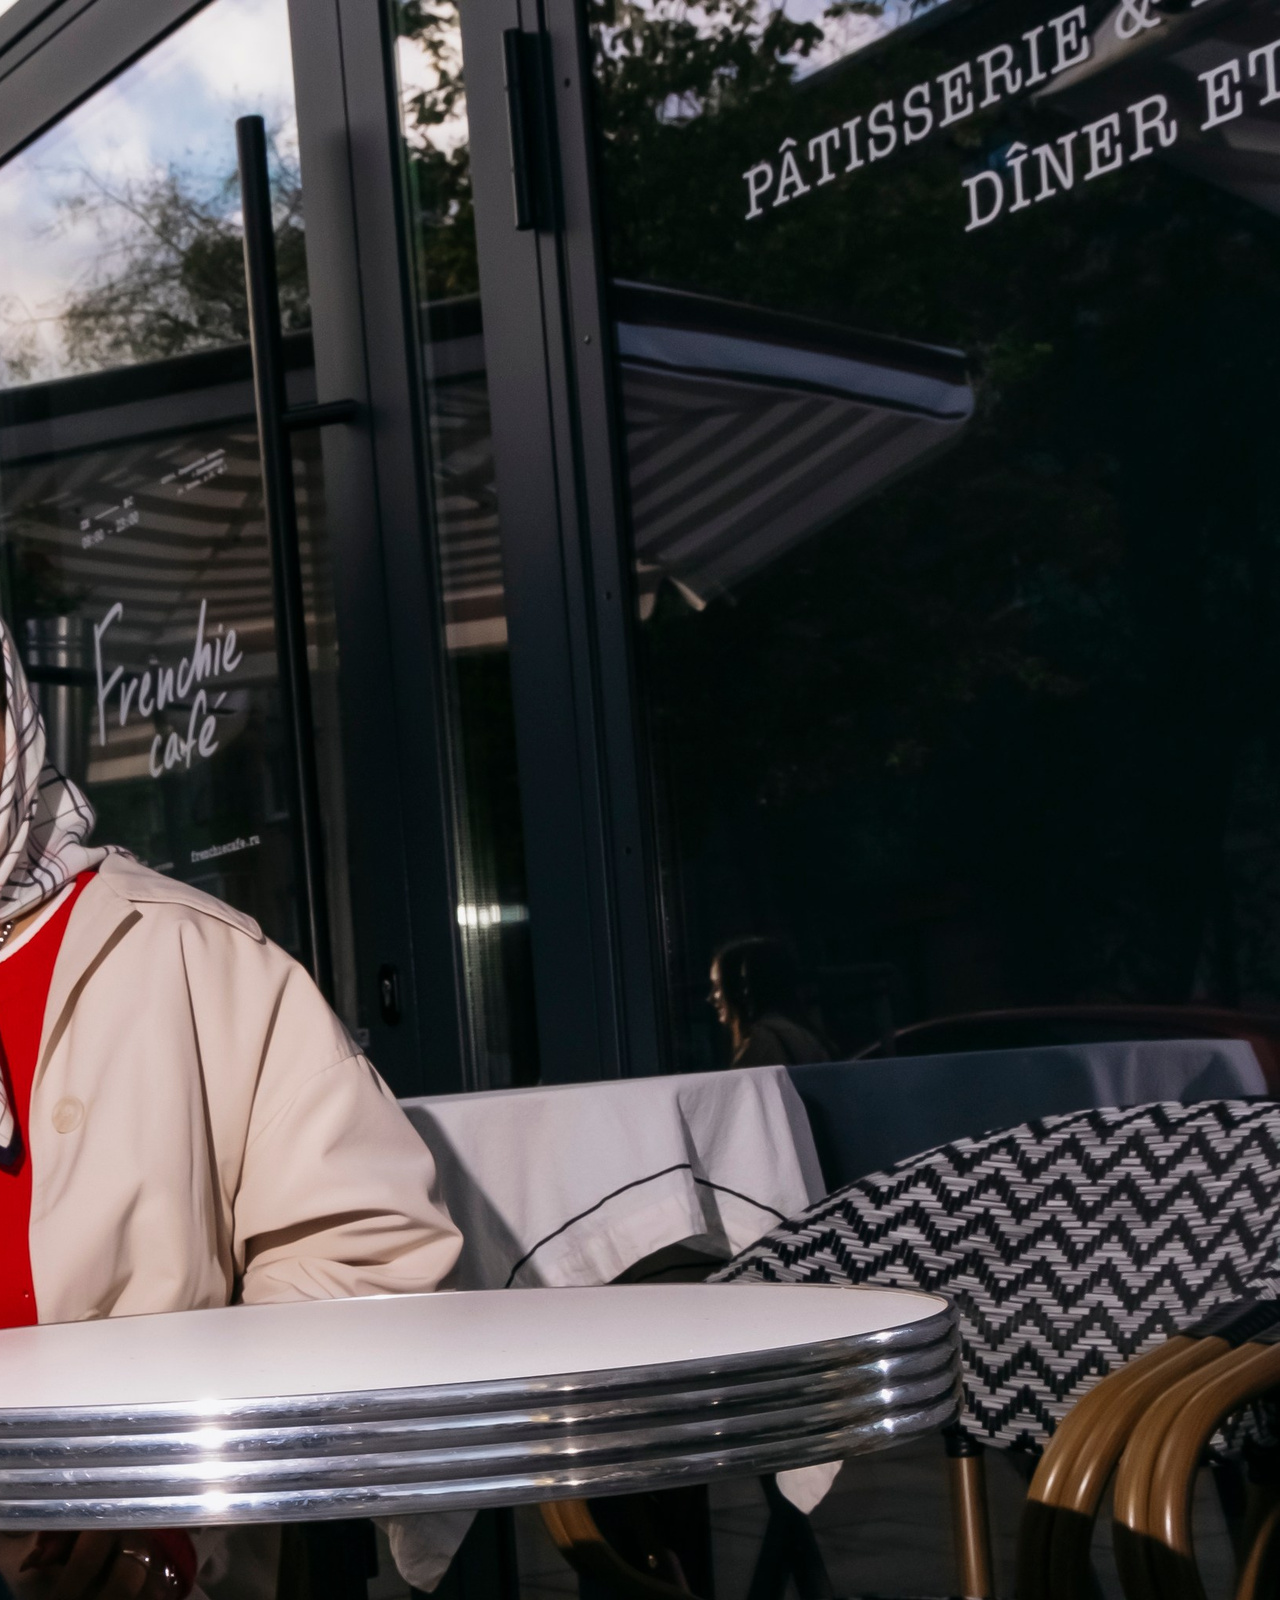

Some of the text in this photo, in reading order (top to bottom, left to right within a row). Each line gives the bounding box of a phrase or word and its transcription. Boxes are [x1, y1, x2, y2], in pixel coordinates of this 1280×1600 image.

[742, 0, 1162, 220] PÂTISSERIE &
[962, 39, 1280, 232] DÎNER ET
[94, 598, 243, 746] Frenchie
[149, 689, 227, 778] café
